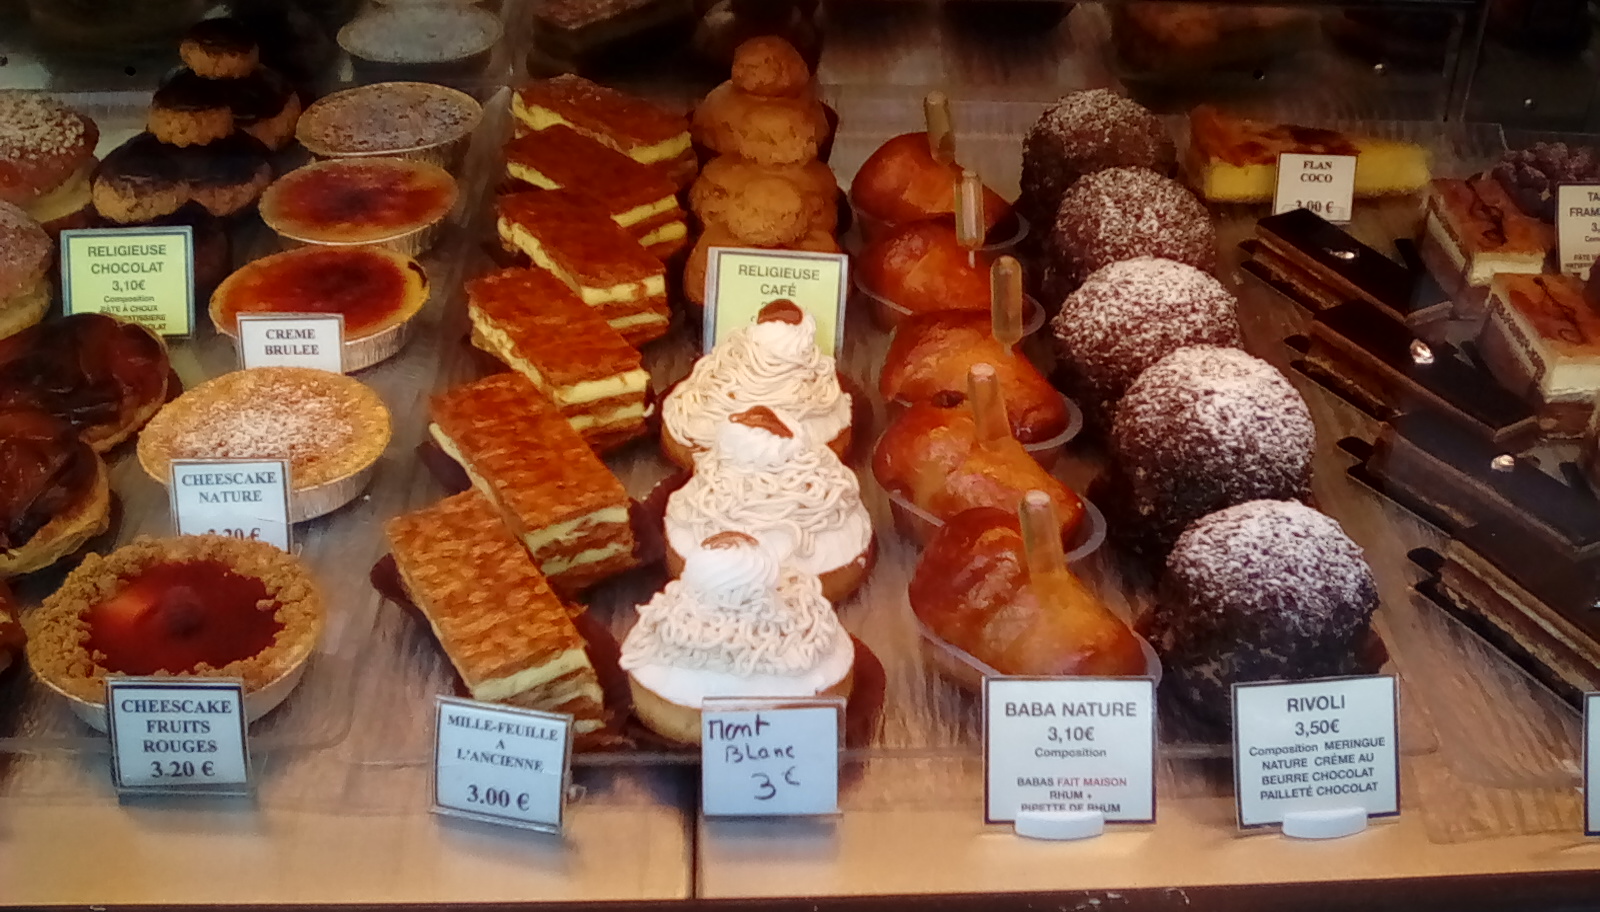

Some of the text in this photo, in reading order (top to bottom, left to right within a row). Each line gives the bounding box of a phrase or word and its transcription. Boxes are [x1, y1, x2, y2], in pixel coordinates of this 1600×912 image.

[1303, 161, 1333, 169] FLAN
[1300, 173, 1333, 183] COCO
[1587, 192, 1600, 201] TA
[1569, 207, 1600, 217] FRAM
[88, 245, 166, 257] RELIGIEUSE
[91, 262, 164, 274] CHOCOLAT
[738, 264, 820, 281] RELIGIEUSE
[112, 280, 146, 292] 3,10€
[760, 283, 796, 297] CAFÉ
[104, 295, 155, 303] Composition
[265, 329, 316, 340] CREME
[264, 345, 319, 355] BRULEE
[181, 472, 277, 486] CHEESCAKE
[199, 490, 262, 503] NATURE
[121, 699, 232, 713] CHEESCAKE
[1005, 702, 1137, 717] BABA NATURE
[1287, 695, 1345, 713] RIVOLI
[146, 720, 210, 733] FRUITS
[447, 714, 558, 741] MILLE-FEUILLE
[1295, 719, 1340, 738] 3,50€
[1047, 727, 1095, 743] 3,10€
[143, 740, 217, 753] ROUGES
[495, 740, 505, 749] A
[1249, 737, 1385, 757] Composition MERINGUE
[1034, 748, 1107, 759] Composition
[1262, 758, 1308, 770] NATURE
[1358, 753, 1374, 763] AU
[151, 761, 215, 778] 3.20 €
[1261, 767, 1375, 785] BEURRE CHOCOLAT
[751, 772, 776, 800] 3
[1017, 777, 1127, 787] BABAS FAIT MAISON
[467, 784, 530, 811] 3.00 €
[1049, 791, 1083, 800] RHUM
[1260, 782, 1379, 800] PAILLETÉ CHOCOLAT
[1087, 803, 1121, 813] RHUM
